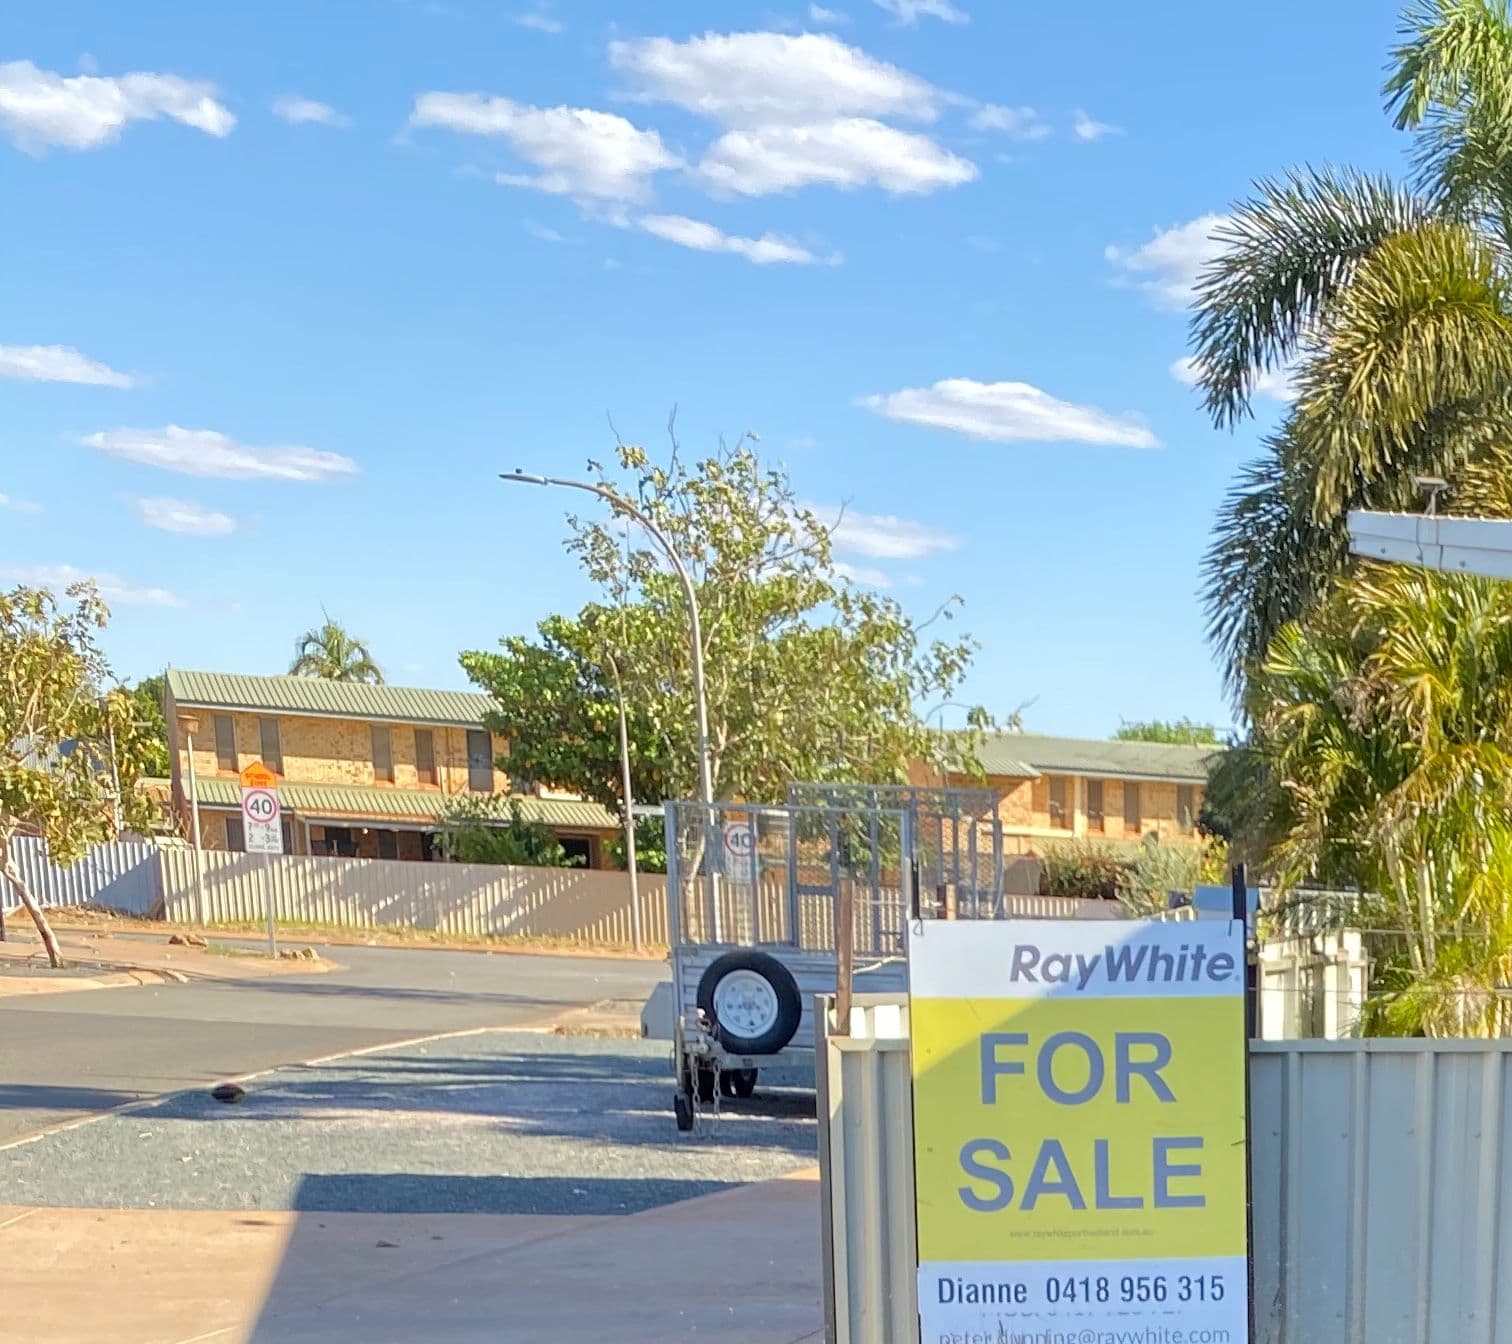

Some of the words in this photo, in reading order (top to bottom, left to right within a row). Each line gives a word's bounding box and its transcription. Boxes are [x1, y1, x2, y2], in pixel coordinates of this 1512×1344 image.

[250, 799, 272, 814] 40
[731, 832, 752, 848] 40
[979, 1031, 1177, 1105] FOR
[957, 1136, 1206, 1212] SALE
[938, 1277, 1028, 1304] Dianne
[1045, 1276, 1110, 1302] 0418
[1120, 1276, 1167, 1302] 956
[1178, 1275, 1225, 1301] 315
